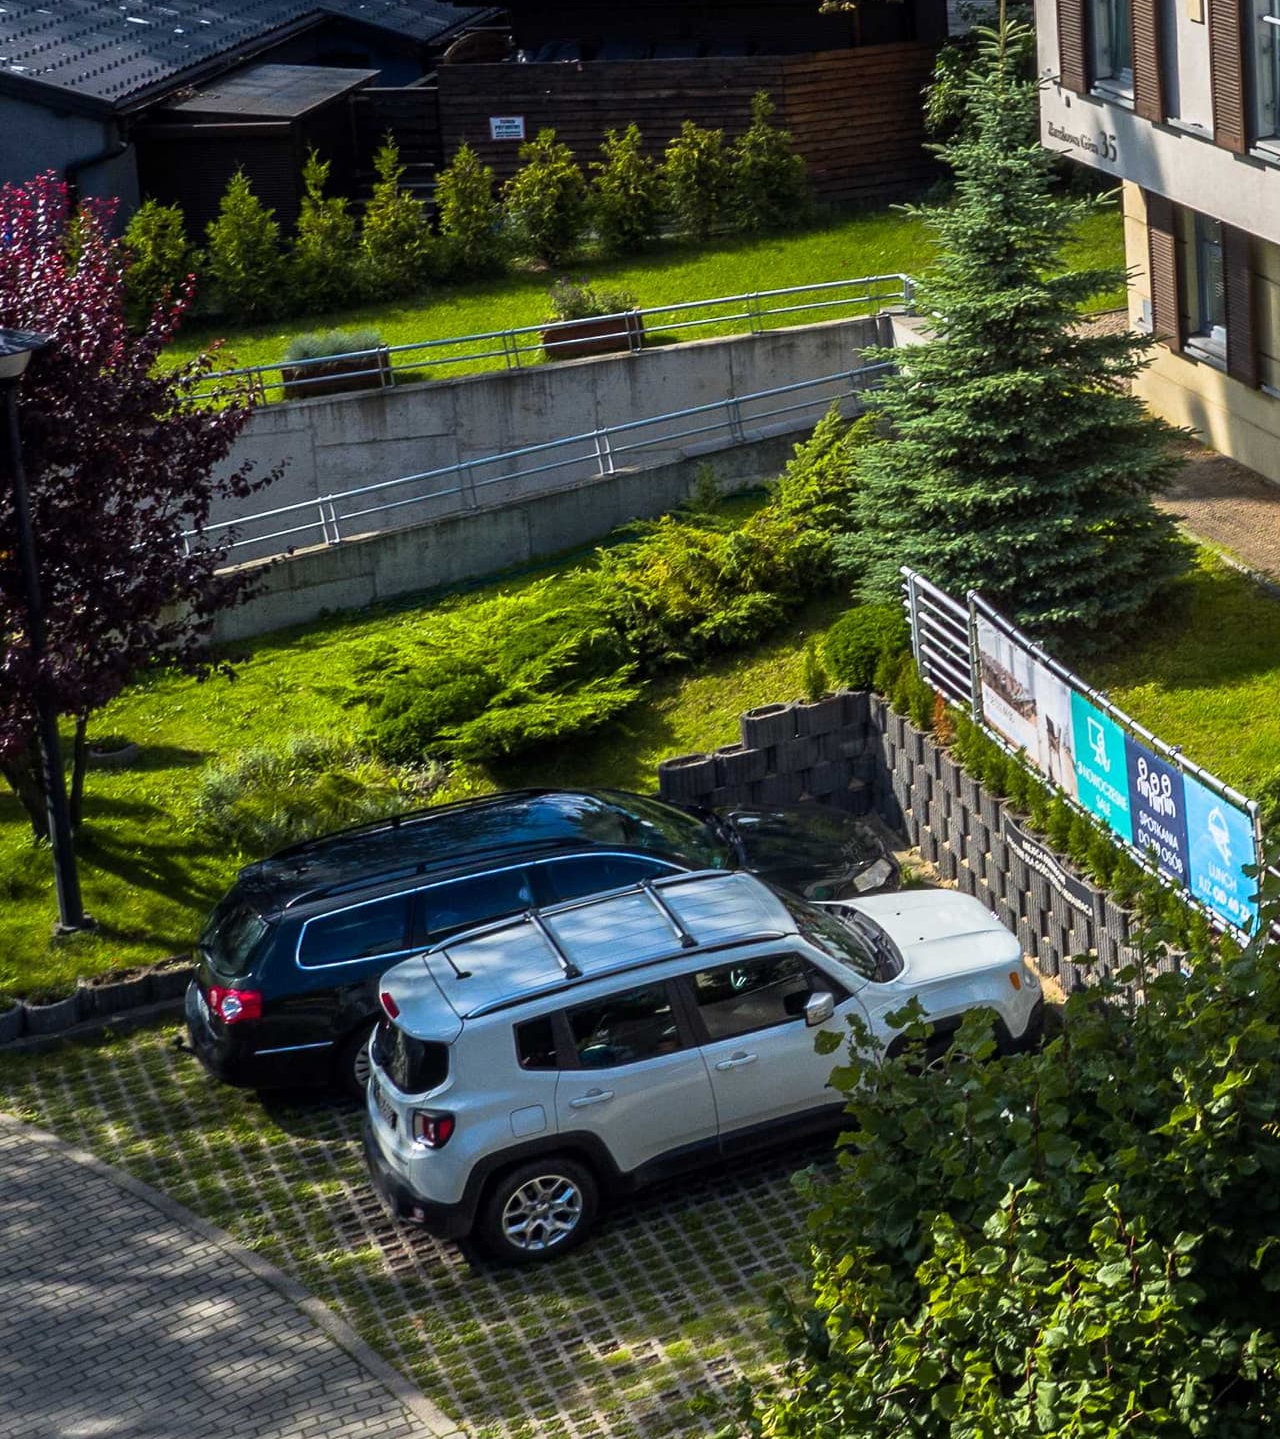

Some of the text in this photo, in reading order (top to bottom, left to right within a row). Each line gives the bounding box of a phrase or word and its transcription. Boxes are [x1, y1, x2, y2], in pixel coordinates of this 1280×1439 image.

[1099, 130, 1118, 163] 35
[1137, 828, 1151, 849] DO
[1138, 809, 1180, 852] SPOTKANIA
[1208, 861, 1237, 893] LUNCH
